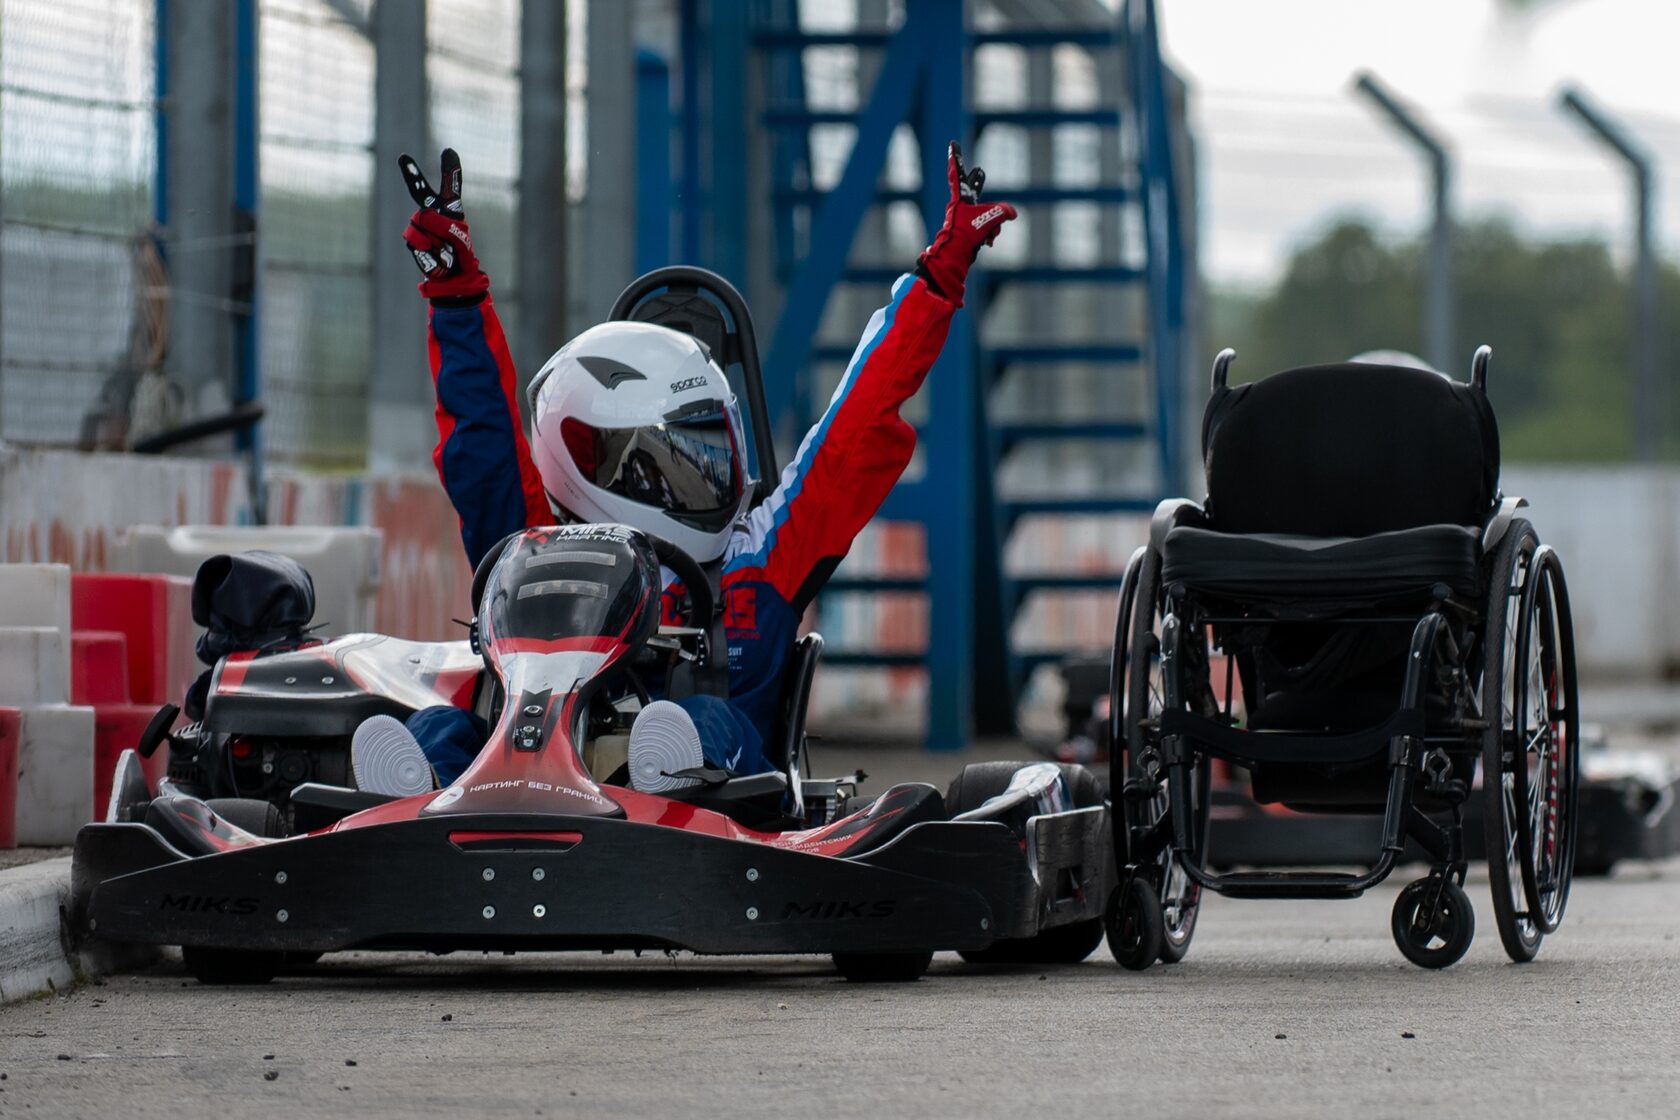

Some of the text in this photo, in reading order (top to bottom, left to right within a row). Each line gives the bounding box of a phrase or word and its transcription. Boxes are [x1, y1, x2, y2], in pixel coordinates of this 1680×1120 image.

[971, 205, 1004, 230] sparco
[670, 376, 708, 394] sparco
[556, 534, 628, 544] KARTING
[470, 780, 604, 804] КАРТИНГ БЕЗ ГРАНИЦ
[160, 893, 260, 914] MIKS
[783, 900, 897, 919] MIKS
